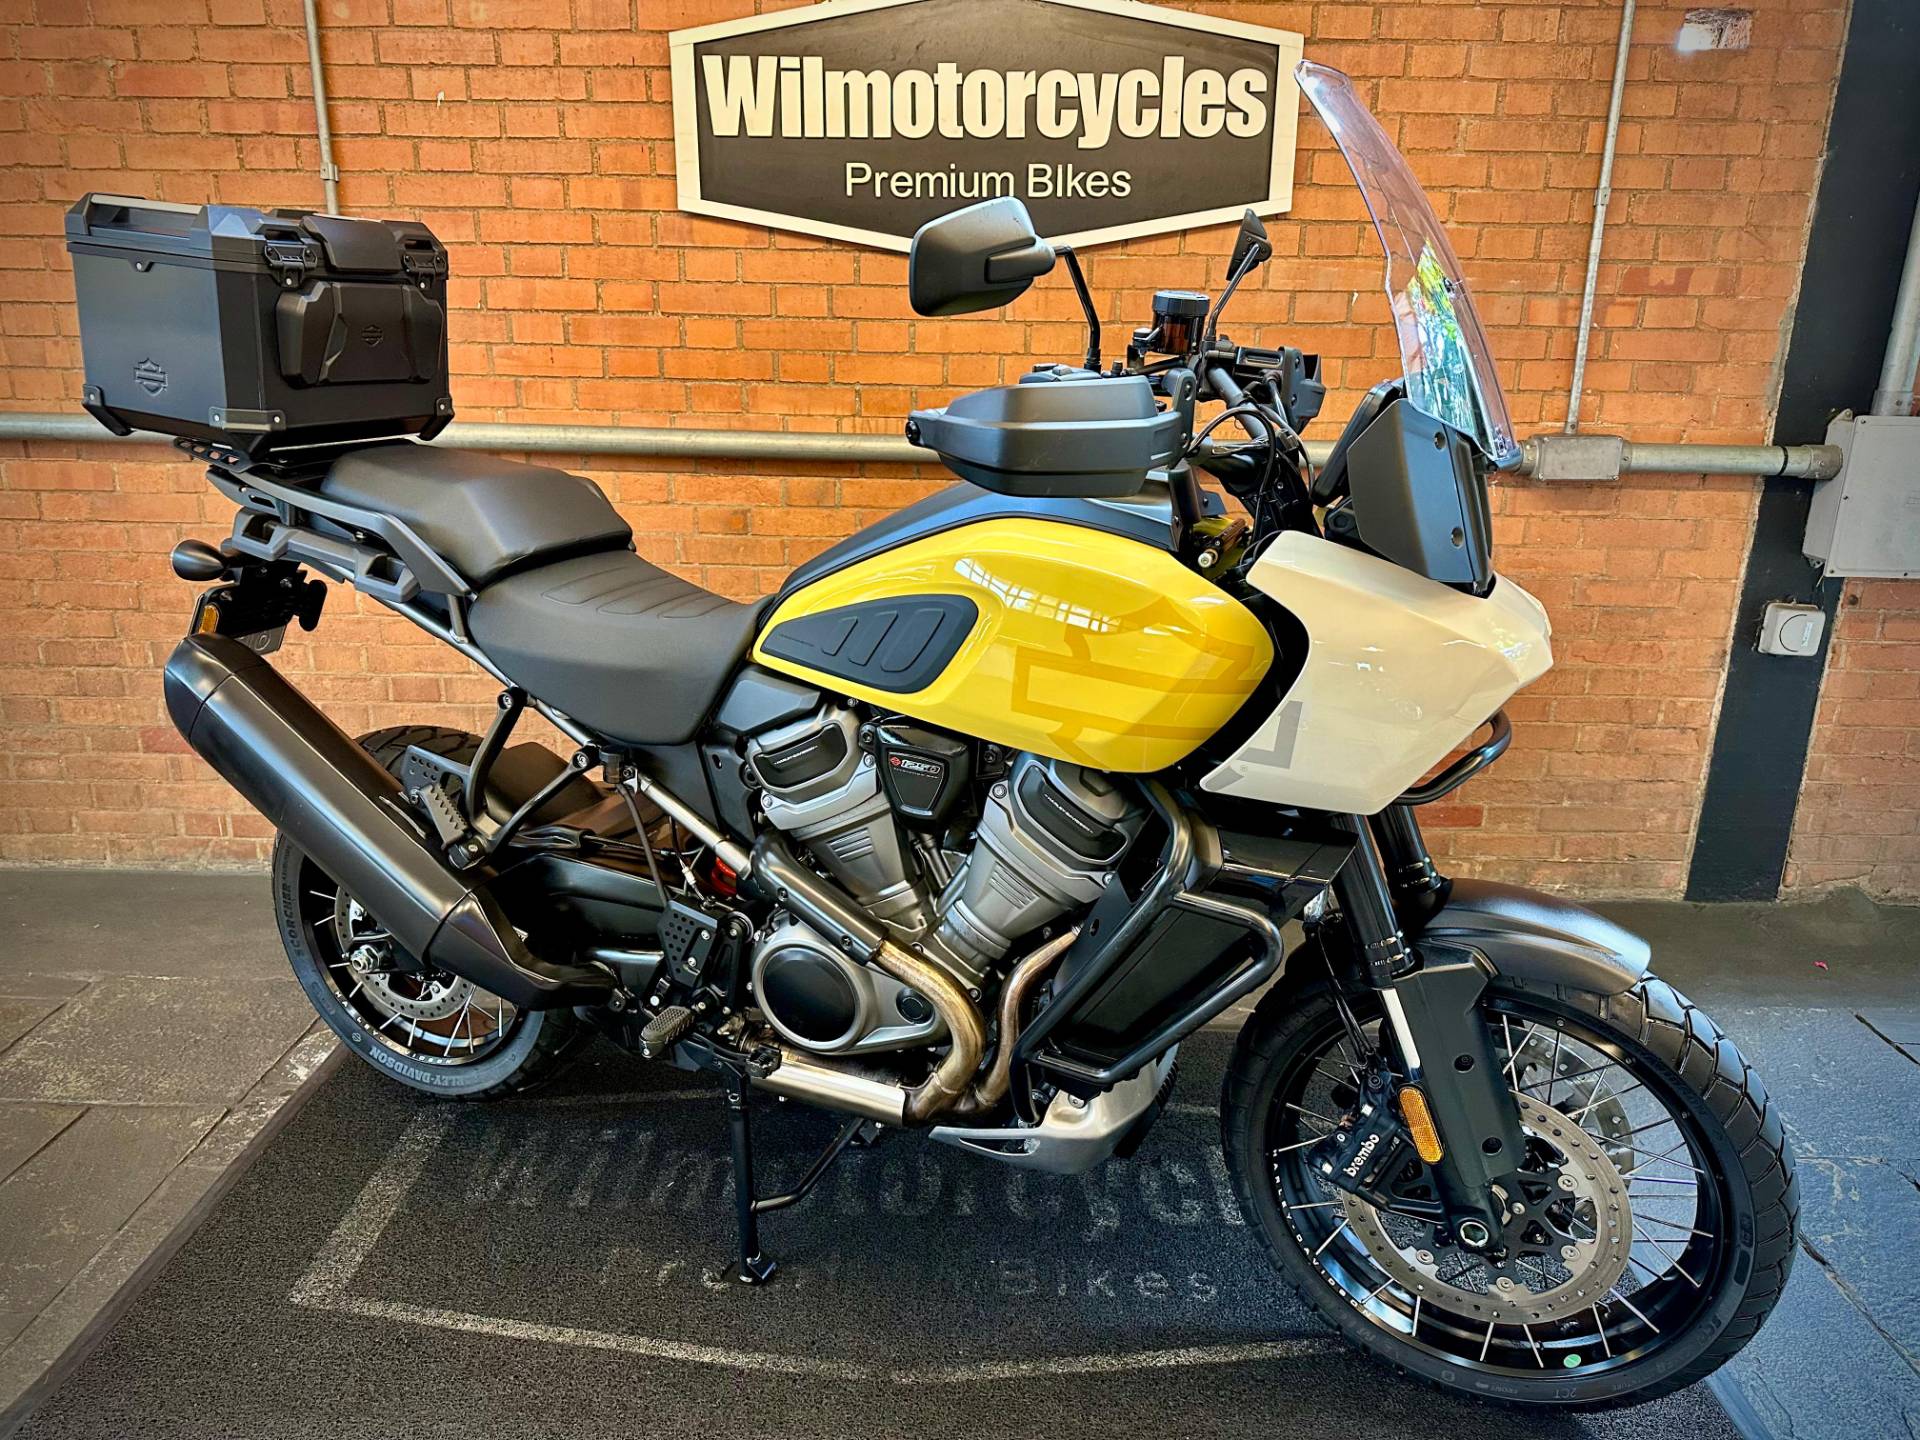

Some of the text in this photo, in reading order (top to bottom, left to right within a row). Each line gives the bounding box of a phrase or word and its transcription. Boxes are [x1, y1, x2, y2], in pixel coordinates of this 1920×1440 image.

[701, 54, 1268, 149] Wilmotorcycles
[844, 162, 1015, 198] Premium
[1342, 1133, 1380, 1178] brembo
